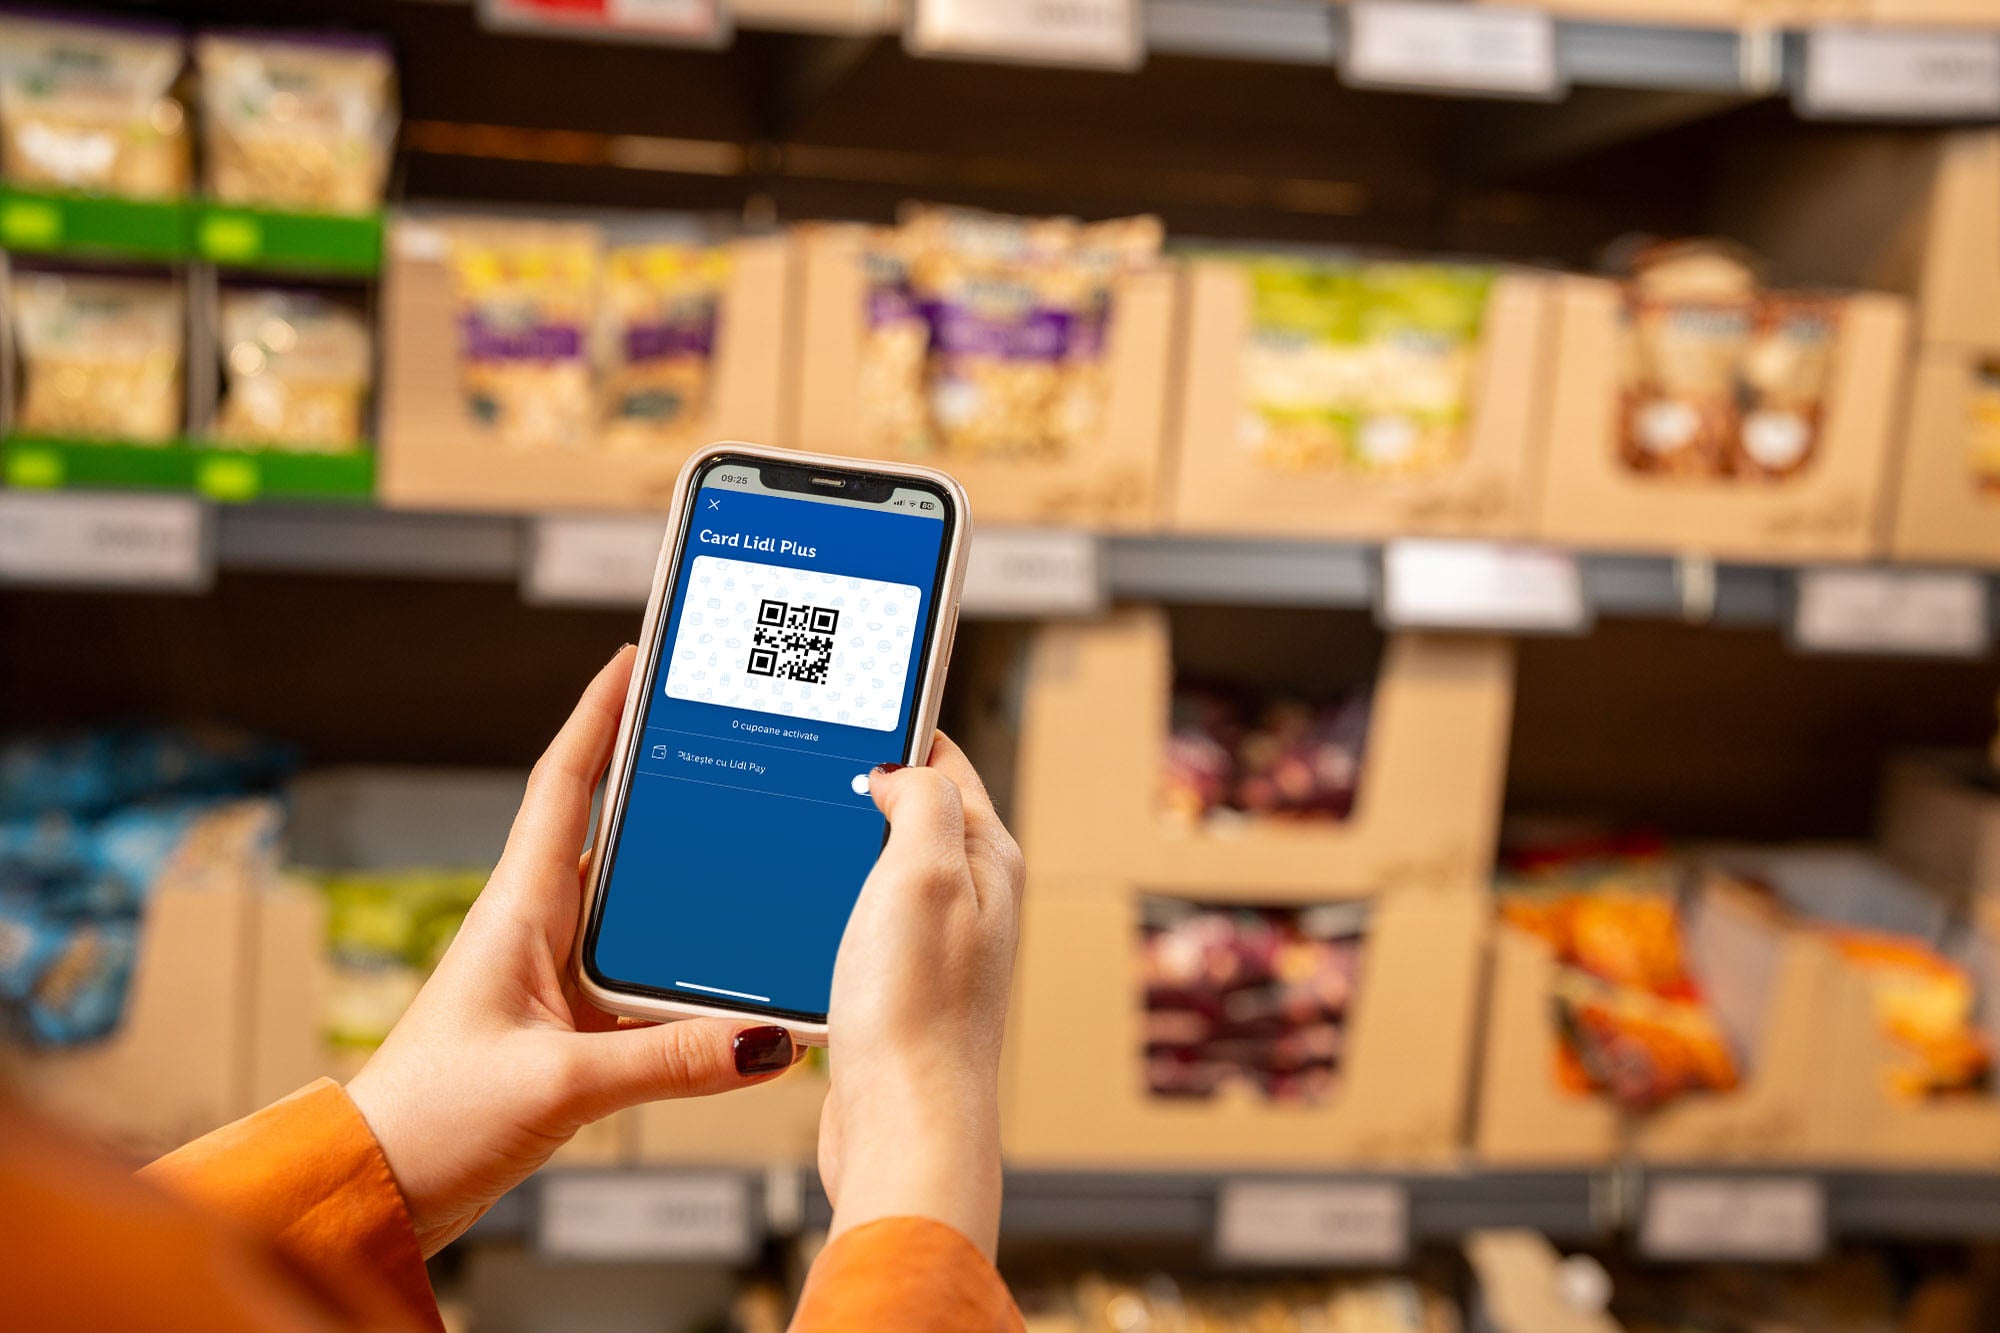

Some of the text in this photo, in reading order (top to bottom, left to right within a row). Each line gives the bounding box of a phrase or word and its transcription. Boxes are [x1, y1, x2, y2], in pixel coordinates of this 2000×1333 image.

[721, 474, 748, 485] 09:25
[699, 529, 817, 558] Card Lidl Plus
[732, 719, 819, 742] 0 cupoane activate
[715, 758, 727, 768] cu
[729, 760, 747, 771] Lidl
[748, 762, 766, 775] Pay
